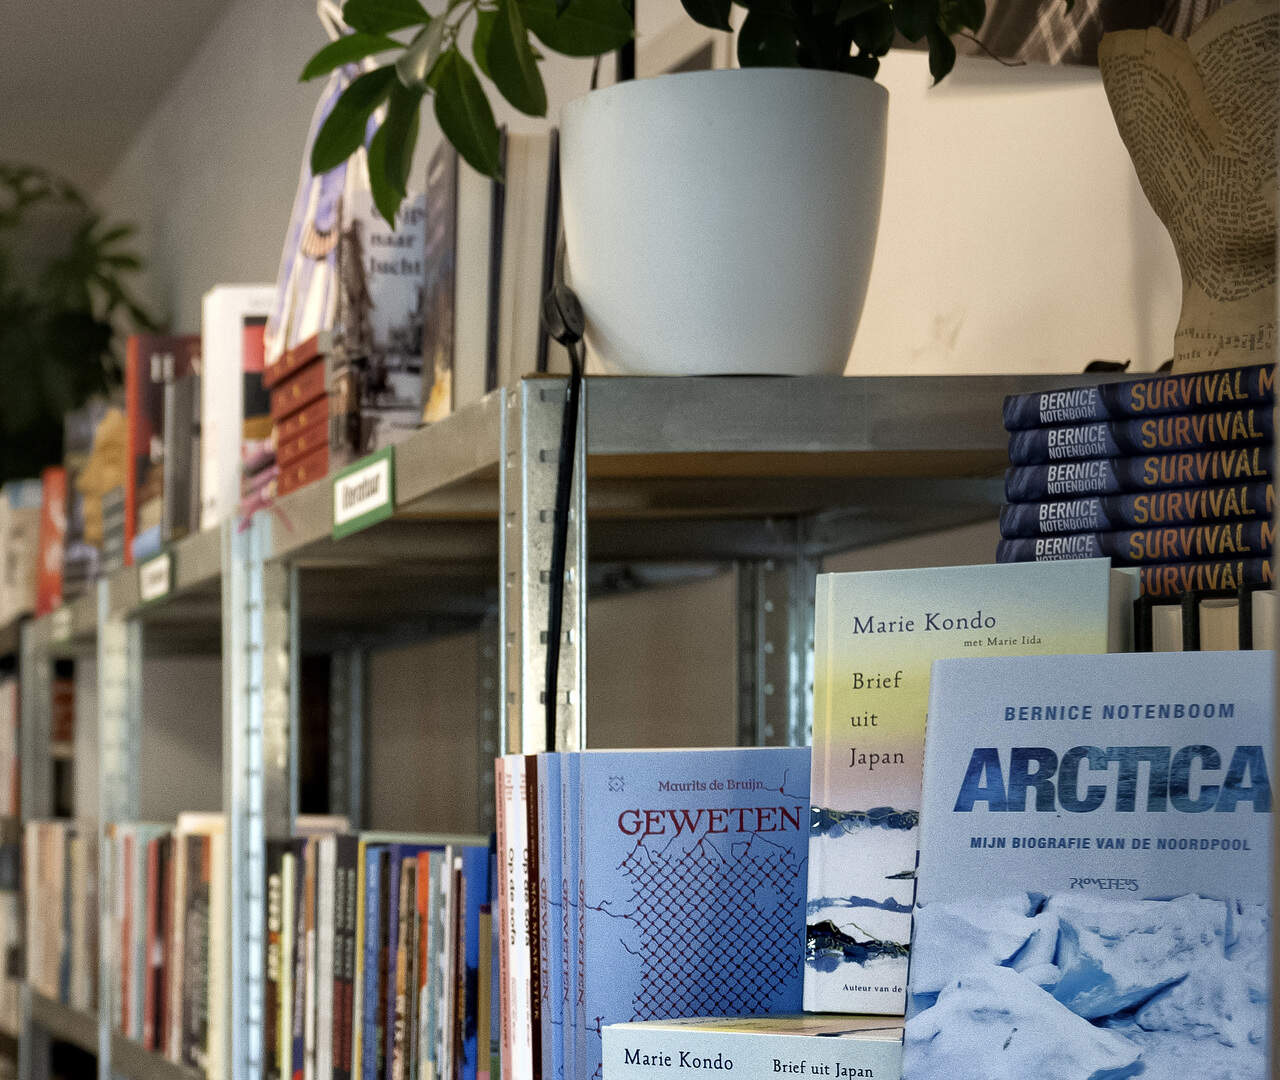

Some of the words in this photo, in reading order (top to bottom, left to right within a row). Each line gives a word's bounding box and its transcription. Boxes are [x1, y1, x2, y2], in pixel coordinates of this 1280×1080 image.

[1040, 388, 1097, 411] BERNICE
[1130, 371, 1249, 412] SURVIVAL
[1040, 405, 1097, 424] NOTENBOOM
[1048, 425, 1107, 447] BERNICE
[1141, 409, 1264, 449] SURVIVAL
[1048, 443, 1107, 460] NOTENBOOM
[1047, 461, 1107, 483] BERNICE
[1143, 447, 1267, 485] SURVIVAL
[1047, 479, 1107, 495] NOTENBOOM
[1039, 500, 1098, 521] BERNICE
[1134, 486, 1256, 524] SURVIVAL
[1039, 517, 1098, 533] NOTENBOOM
[1036, 535, 1095, 556] BERNICE
[1129, 523, 1251, 560] SURVIVAL
[852, 615, 915, 634] Marie
[924, 611, 997, 632] Kondo
[963, 638, 982, 647] met
[987, 637, 1017, 646] Marie
[1021, 636, 1042, 645] Iida
[852, 671, 903, 690] Brief
[850, 712, 878, 727] uit
[1004, 705, 1092, 721] BERNICE
[1102, 703, 1235, 720] NOTENBOOM
[849, 748, 905, 771] Japan
[658, 780, 707, 792] Maurits
[709, 781, 724, 791] de
[727, 779, 764, 793] Bruijn
[953, 744, 1274, 813] ARCTICA
[618, 806, 803, 836] GEWETEN
[970, 836, 1006, 849] MIJN
[1012, 836, 1091, 849] BIOGRAFIE
[1096, 838, 1125, 850] VAN
[1132, 838, 1150, 850] DE
[1157, 838, 1251, 851] NOORDPOOL
[508, 848, 515, 873] Op
[509, 879, 516, 902] de
[540, 877, 549, 1002] GEWETEN
[562, 878, 570, 1002] GEWETEN
[842, 983, 872, 993] Auteur
[874, 985, 890, 993] van
[892, 984, 903, 993] de
[624, 1048, 672, 1067] Marie
[679, 1051, 733, 1071] Kondo
[773, 1059, 805, 1074] Brief
[811, 1062, 830, 1076] uit
[834, 1063, 874, 1080] Japan
